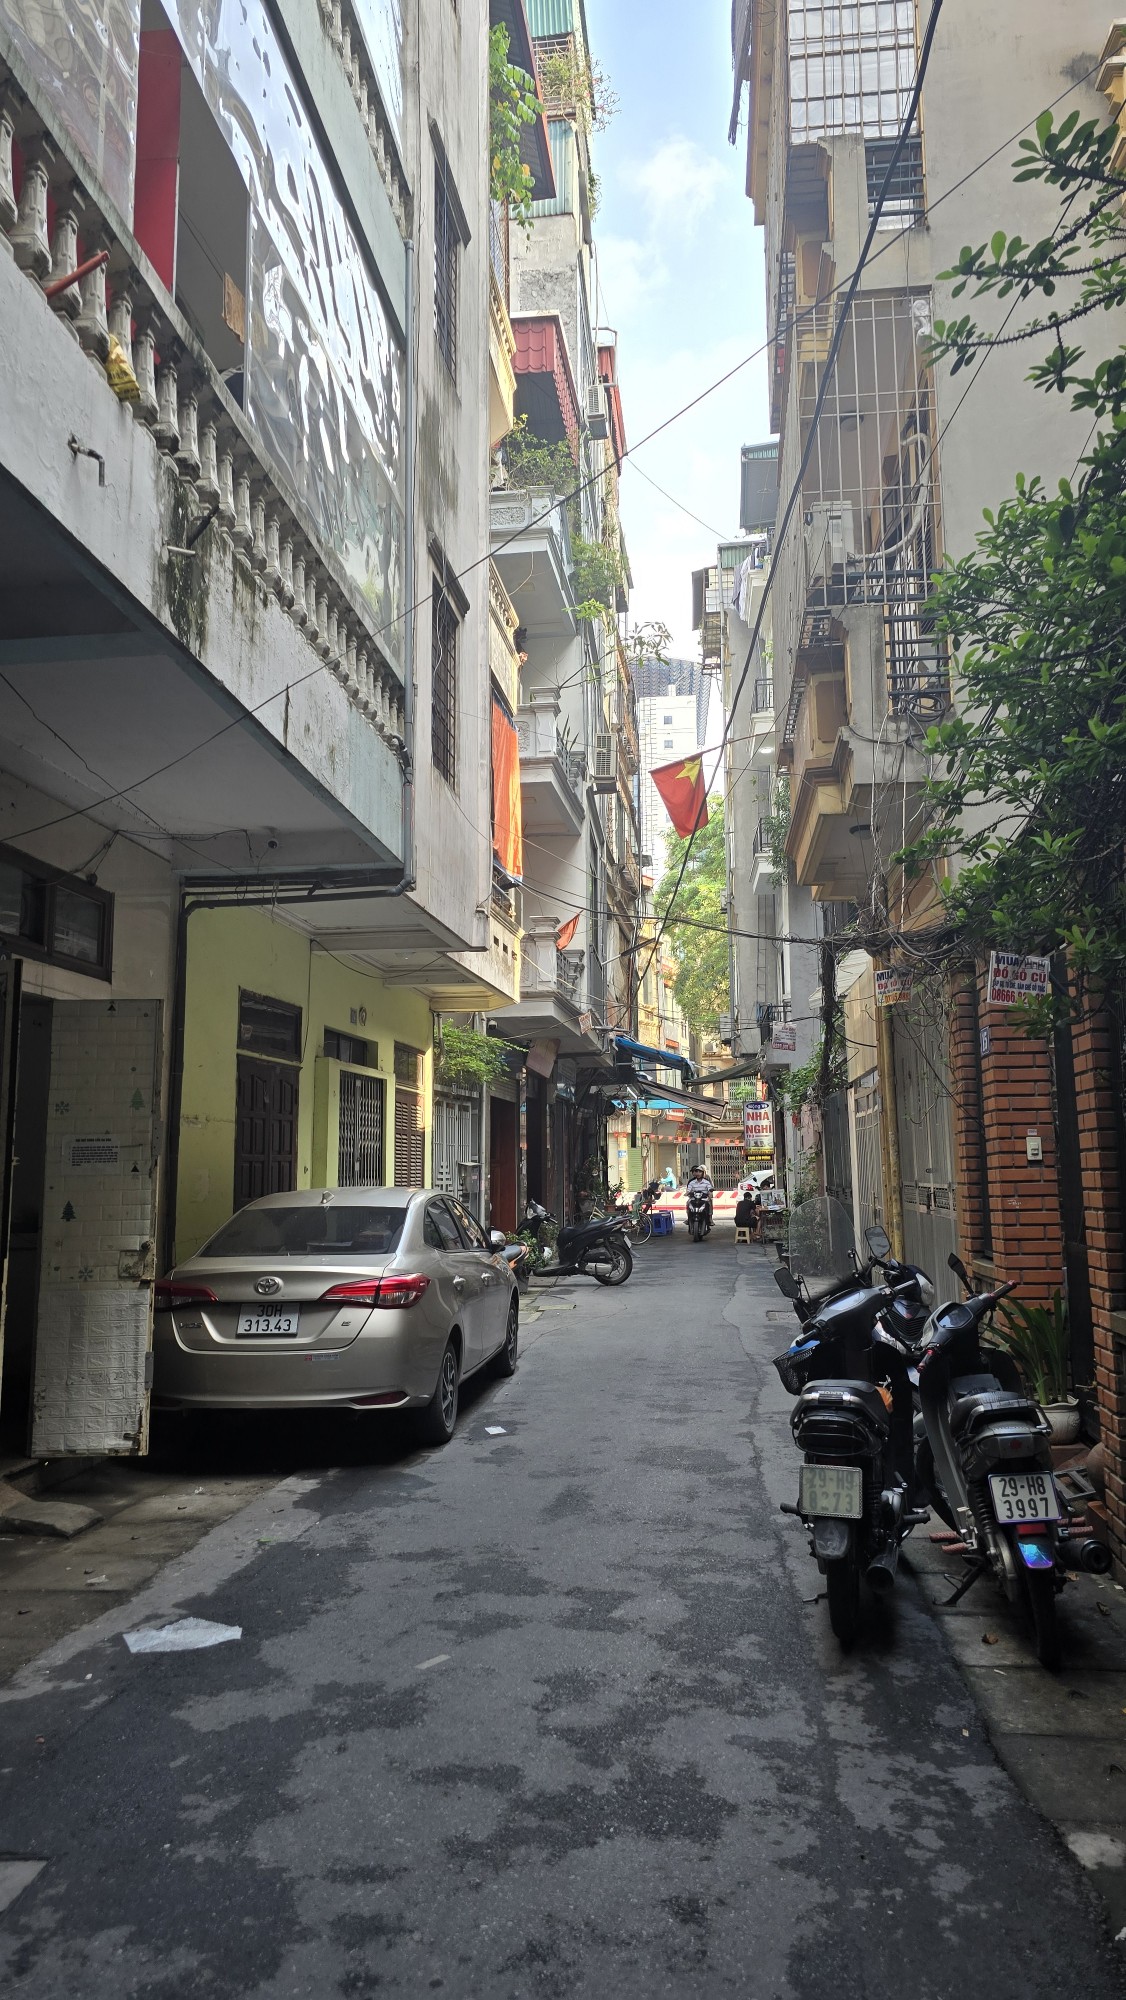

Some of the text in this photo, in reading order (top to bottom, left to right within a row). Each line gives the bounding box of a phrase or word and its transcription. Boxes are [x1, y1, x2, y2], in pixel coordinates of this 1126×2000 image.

[994, 955, 1019, 967] MUA
[745, 1121, 772, 1134] NGHỈ
[256, 1304, 283, 1317] 30H
[244, 1319, 292, 1333] 313.43
[808, 1468, 855, 1491] 29-H9
[999, 1475, 1047, 1497] 29-H8
[1003, 1497, 1049, 1519] 3997
